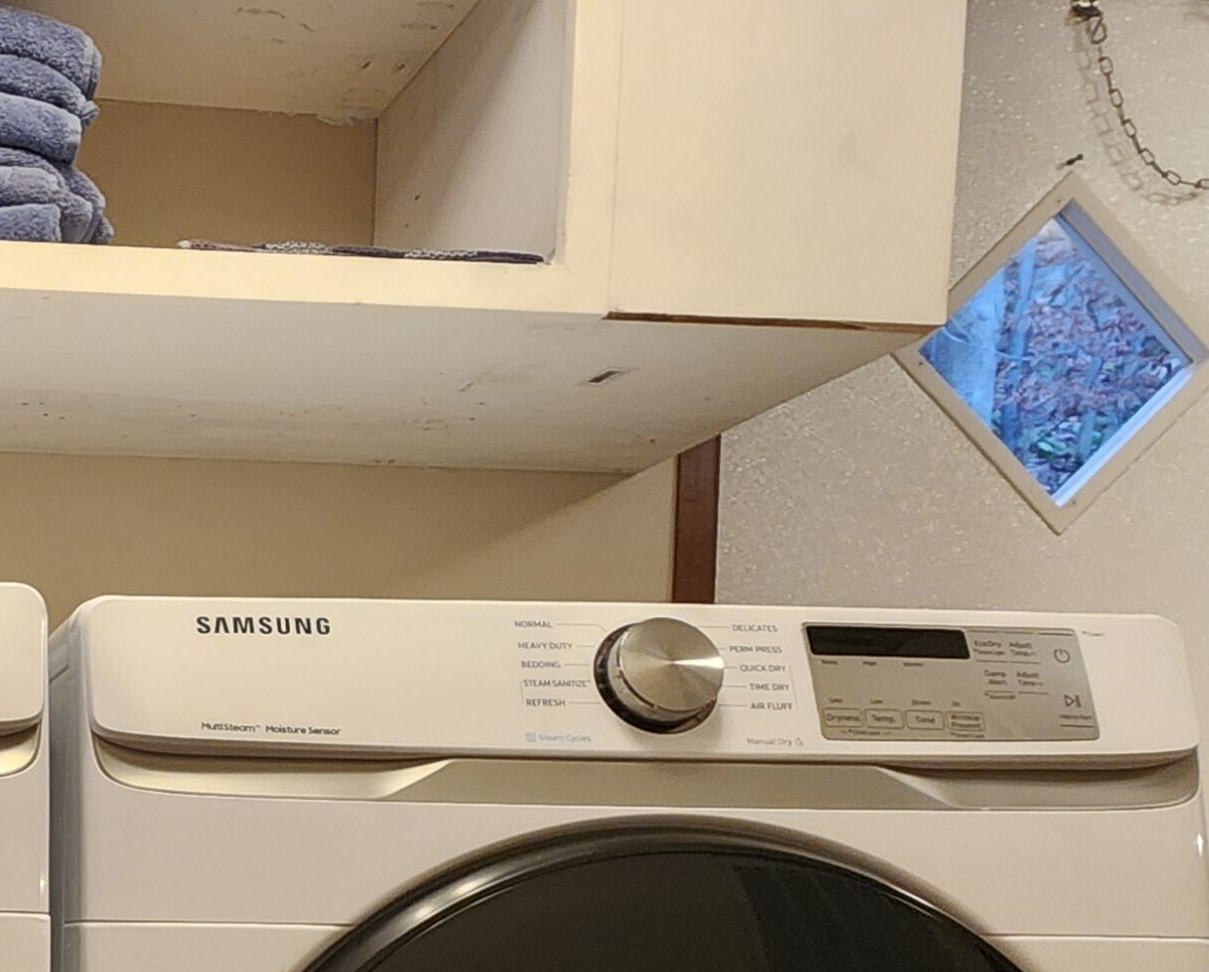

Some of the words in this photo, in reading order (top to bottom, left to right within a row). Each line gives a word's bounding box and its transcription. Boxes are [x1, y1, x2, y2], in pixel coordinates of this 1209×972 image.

[196, 616, 331, 635] SAMSUNG
[514, 620, 553, 628] NORMAL
[732, 624, 778, 632] DELICATES
[729, 645, 754, 653] PERM
[755, 645, 782, 653] PRESS
[520, 660, 561, 669] BEDDING
[740, 664, 767, 673] QUICK
[768, 664, 786, 672] DRY
[523, 679, 551, 688] STEAM
[750, 683, 770, 691] TIME
[772, 683, 790, 691] DRY
[526, 698, 566, 707] REFRESH
[751, 702, 766, 710] AIR
[767, 702, 793, 711] FLUFF
[265, 724, 307, 734] Moisture
[308, 726, 342, 735] Sensor
